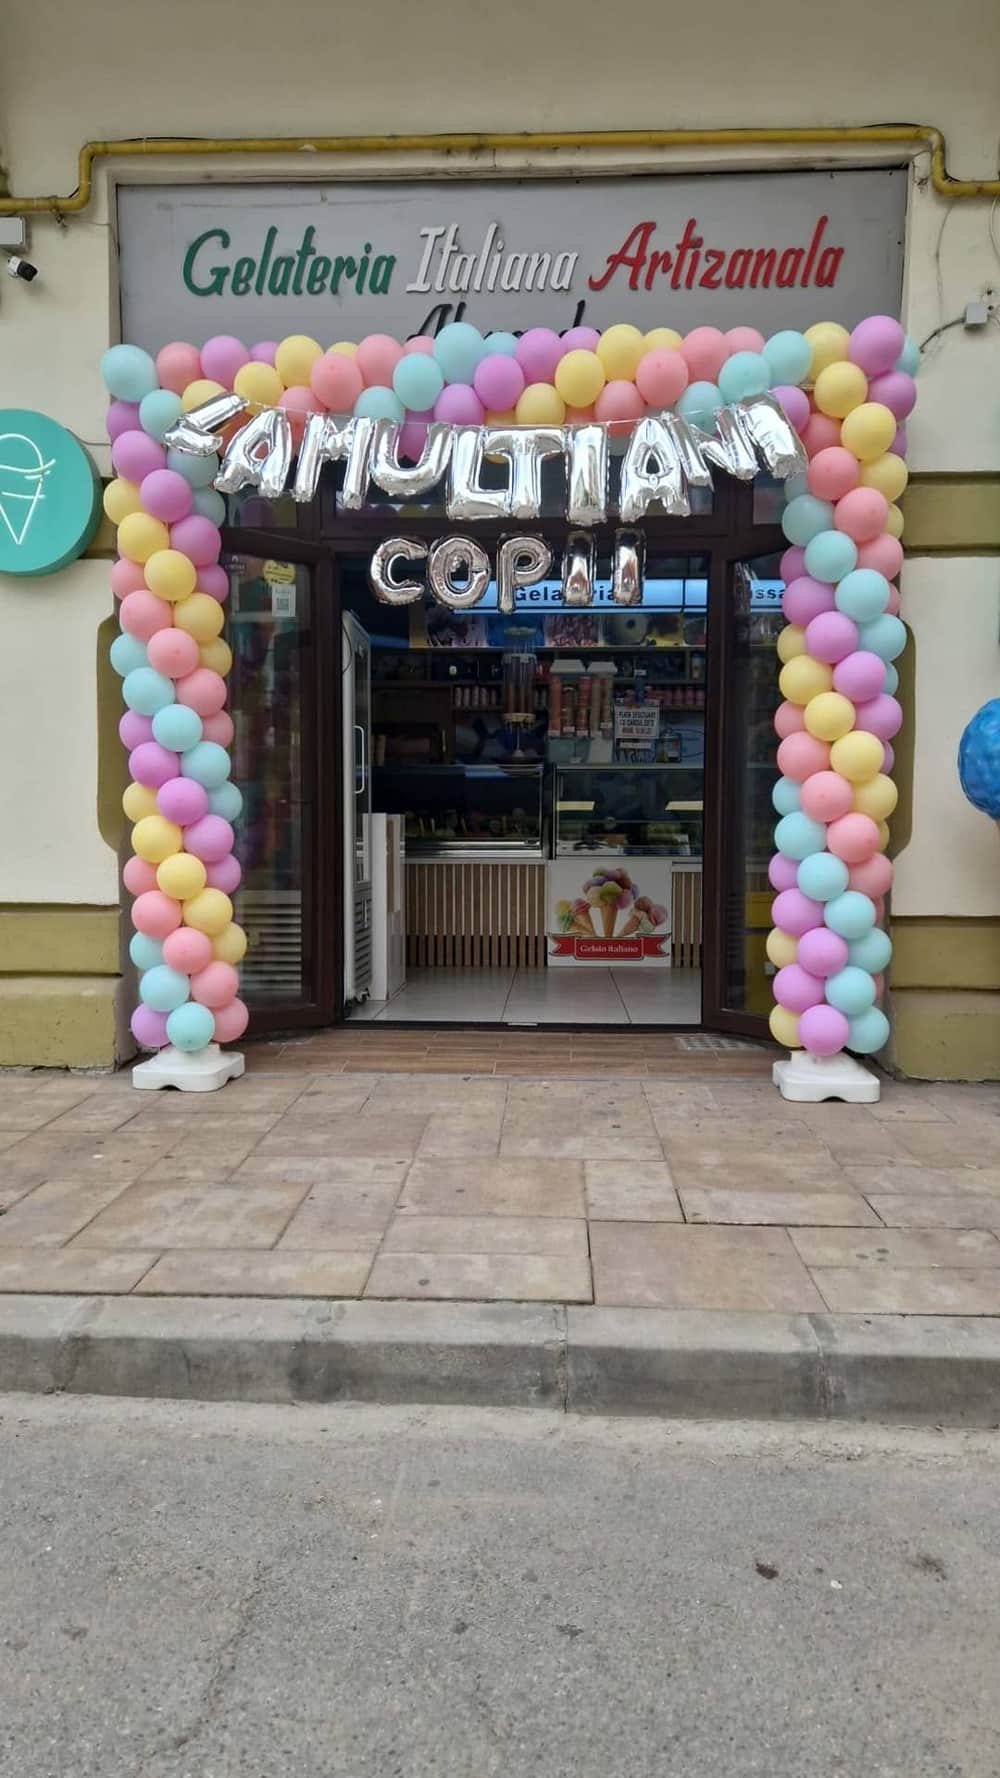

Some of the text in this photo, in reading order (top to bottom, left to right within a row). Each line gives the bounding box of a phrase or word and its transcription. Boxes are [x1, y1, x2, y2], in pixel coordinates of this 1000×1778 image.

[182, 215, 846, 296] Gelateria Italiana Artizanala
[369, 529, 645, 614] COPII
[579, 945, 607, 953] Gelato
